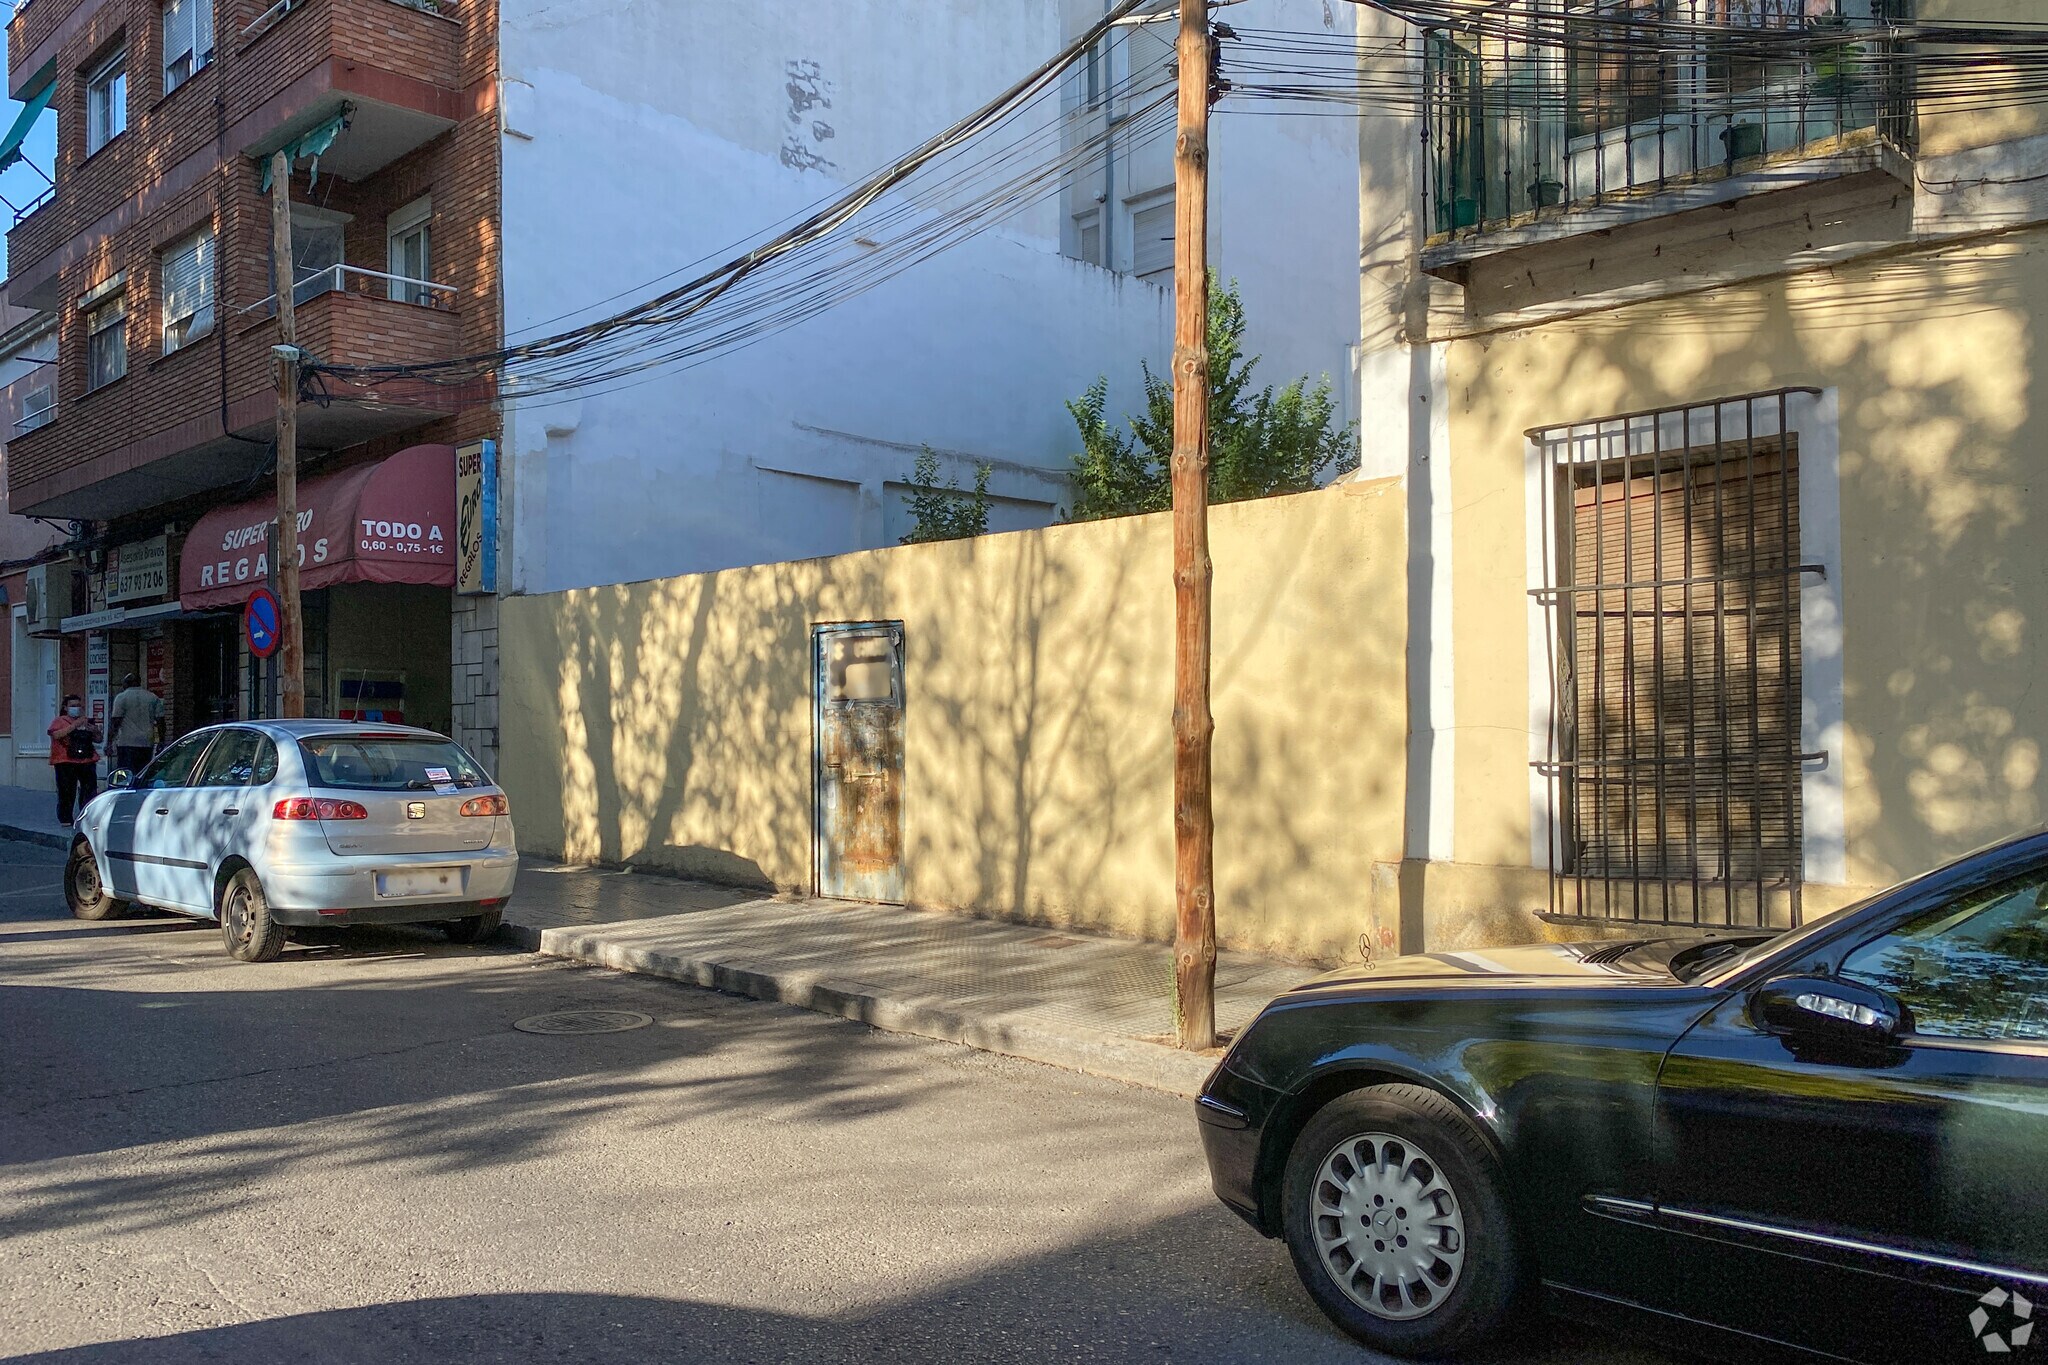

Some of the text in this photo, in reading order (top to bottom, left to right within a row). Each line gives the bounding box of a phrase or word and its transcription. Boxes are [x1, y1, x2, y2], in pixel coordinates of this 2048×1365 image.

[458, 452, 482, 478] SUPER
[361, 519, 444, 541] TODO A
[361, 539, 387, 552] 0,60
[396, 542, 421, 554] 0,75
[429, 544, 444, 554] 1€
[458, 531, 483, 588] REGALOS
[153, 569, 164, 588] 06
